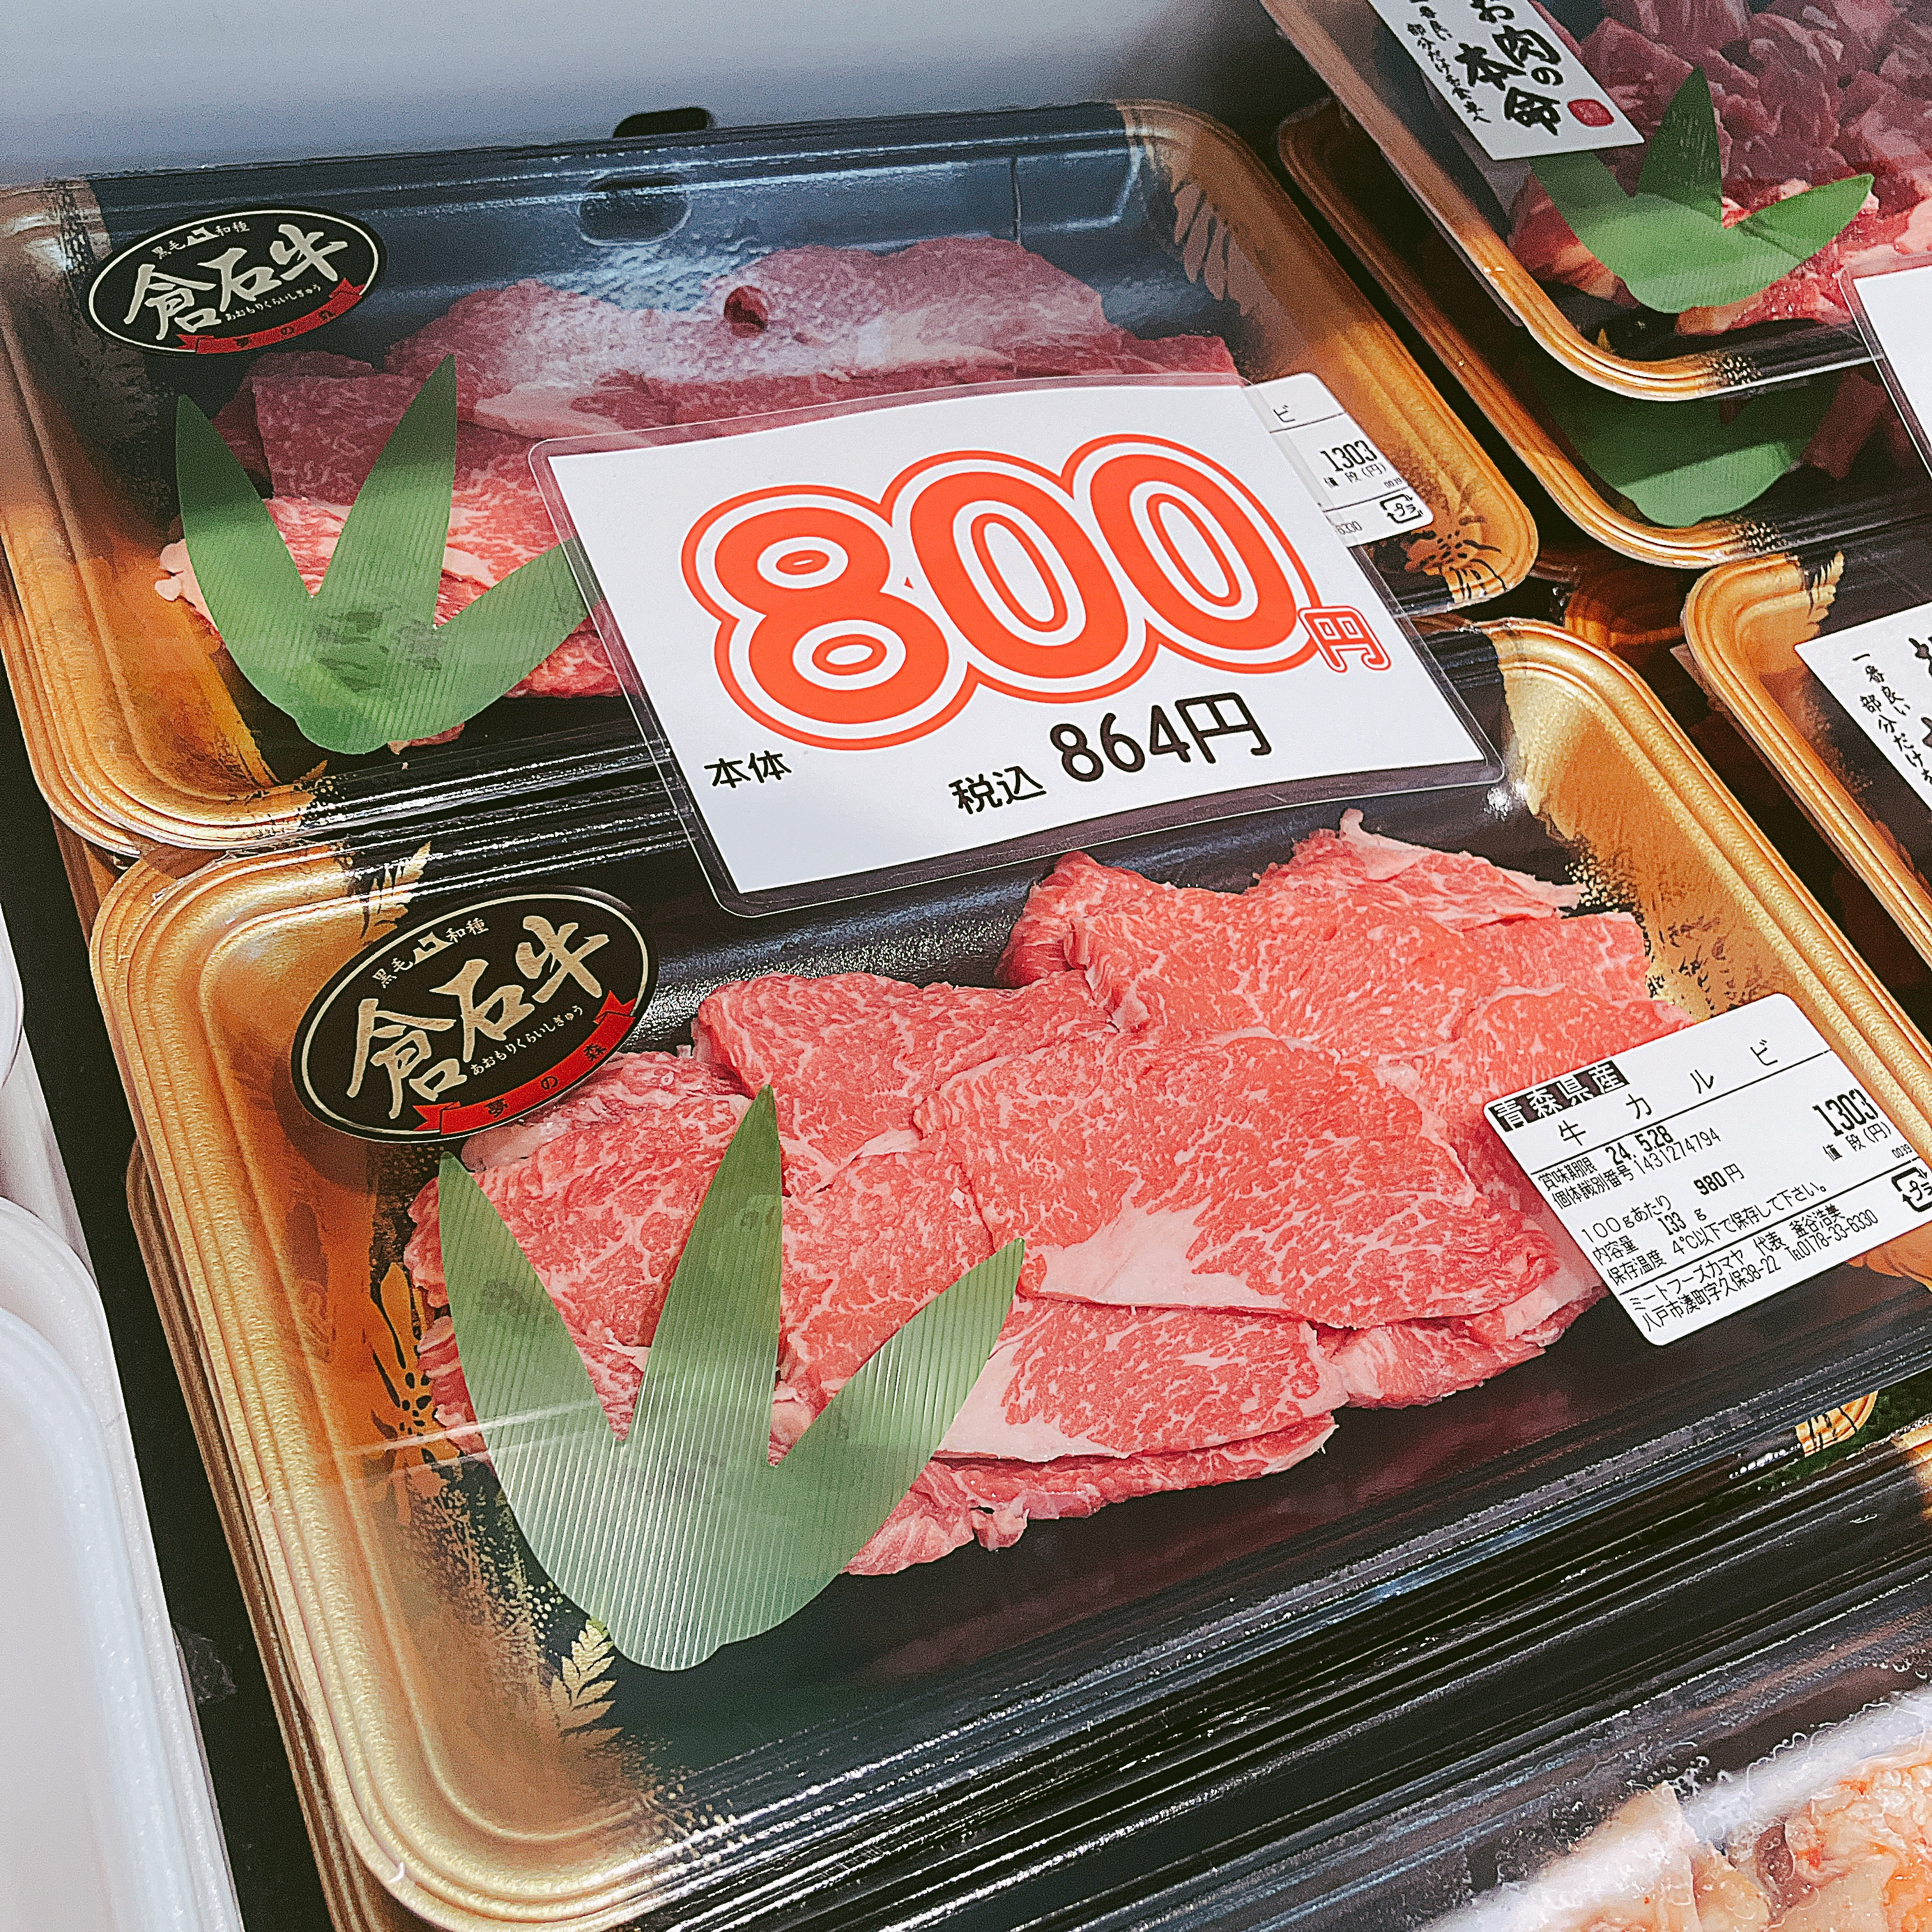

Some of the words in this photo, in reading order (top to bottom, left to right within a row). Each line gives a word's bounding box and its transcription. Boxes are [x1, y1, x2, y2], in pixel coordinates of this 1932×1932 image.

[1455, 42, 1561, 136] 本命
[123, 224, 348, 341] 倉石牛
[151, 240, 187, 260] 黒毛
[1319, 440, 1377, 472] 1303
[1851, 652, 1911, 716] 一番良い
[705, 750, 792, 790] 本体
[949, 766, 1046, 815] 税込
[1049, 692, 1273, 783] 864円
[372, 957, 413, 989] 黒毛
[446, 917, 489, 944] 和種
[346, 915, 610, 1119] 倉石牛
[470, 1005, 584, 1077] あおもりくらいしぎゅう
[1493, 1062, 1625, 1131] 青森県産
[1812, 1088, 1879, 1137] 1303
[1537, 1156, 1598, 1192] 賞味期限
[1552, 1165, 1634, 1209] 個体識別番号
[1633, 1127, 1721, 1175] 1431274794
[1592, 1235, 1639, 1266] 内容量
[1606, 1249, 1667, 1286] 保存温度
[1629, 1249, 1744, 1310] ミートフーズカマヤ
[1752, 1231, 1787, 1256] 代表
